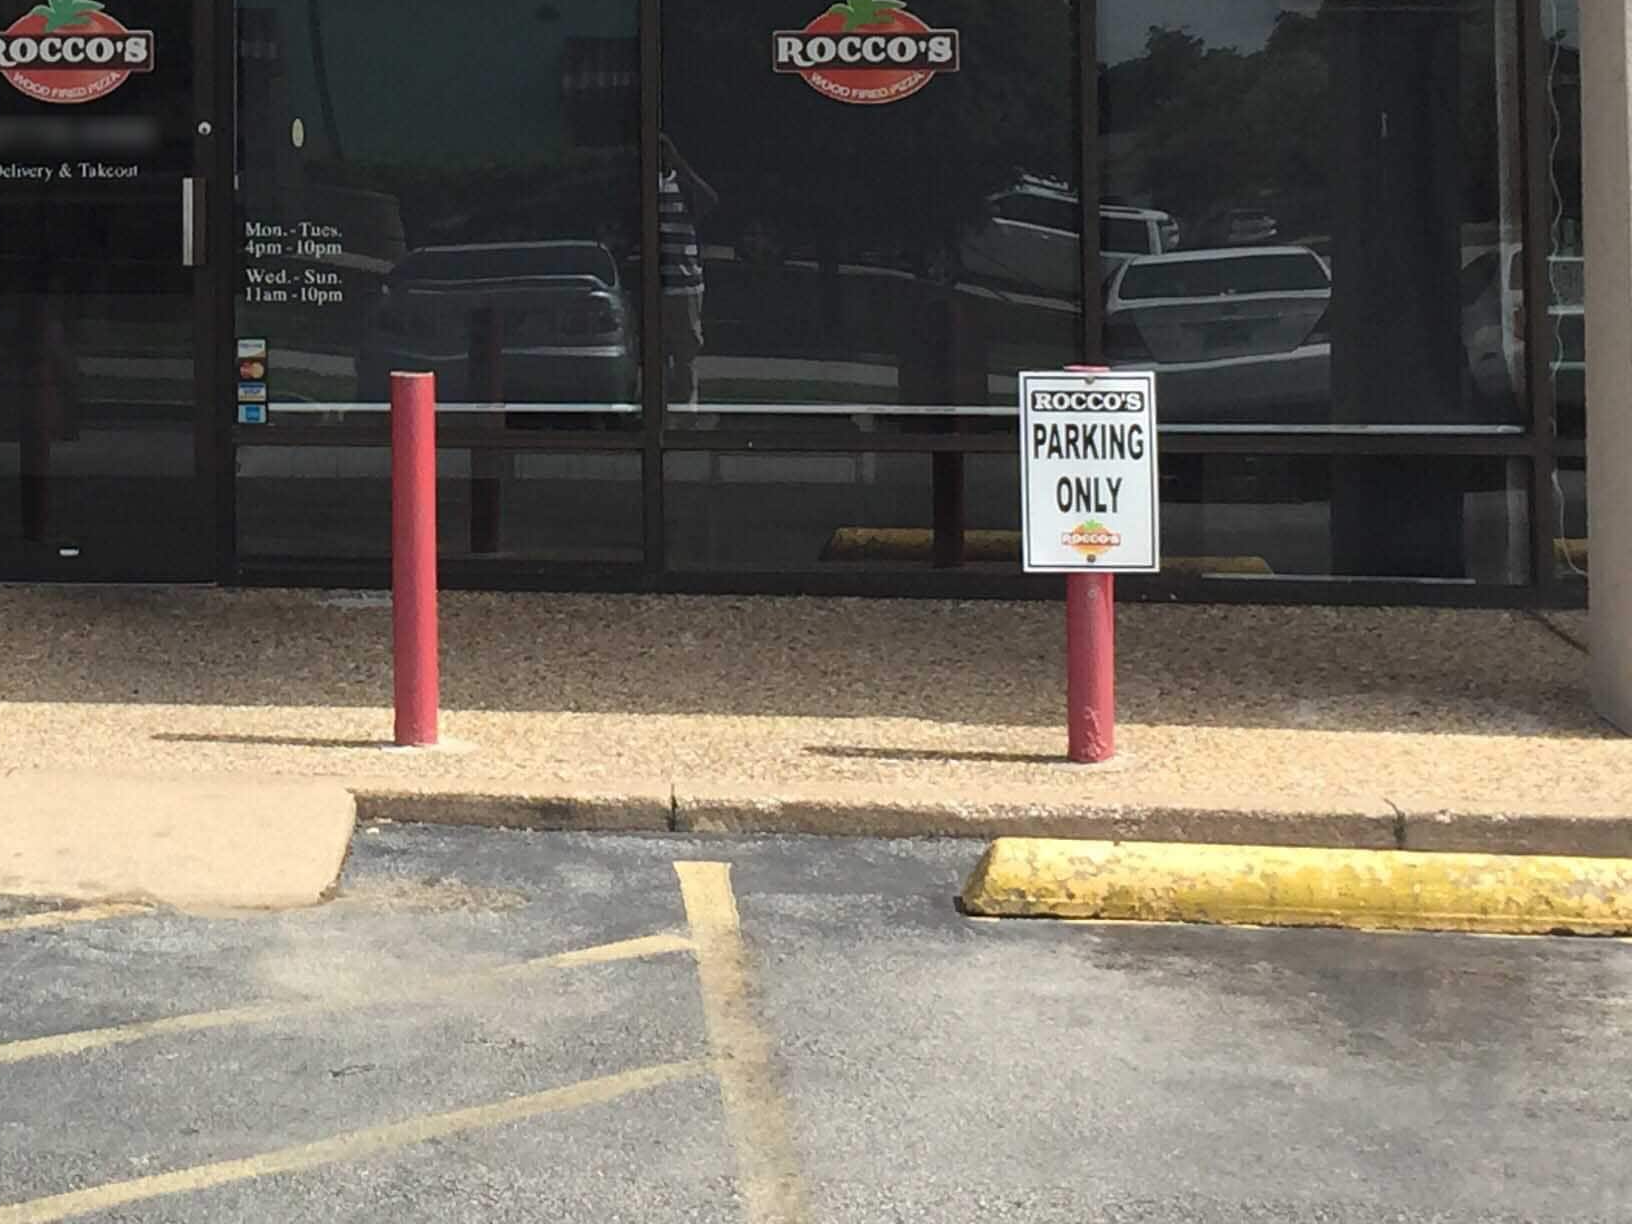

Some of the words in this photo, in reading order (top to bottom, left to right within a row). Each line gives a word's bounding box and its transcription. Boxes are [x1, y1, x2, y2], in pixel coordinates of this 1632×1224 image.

[776, 36, 953, 67] ROCCO'S
[13, 71, 51, 97] WOOD
[51, 86, 88, 99] FIRED
[88, 72, 121, 95] PIZZA
[811, 72, 850, 97] WOOD
[851, 86, 888, 99] FIRED
[59, 163, 72, 178] &
[77, 162, 139, 178] Takeout
[1034, 393, 1142, 410] ROCCO'S
[1033, 423, 1144, 460] PARKING
[1057, 477, 1122, 513] ONLY
[1062, 533, 1120, 545] ROCCO'S
